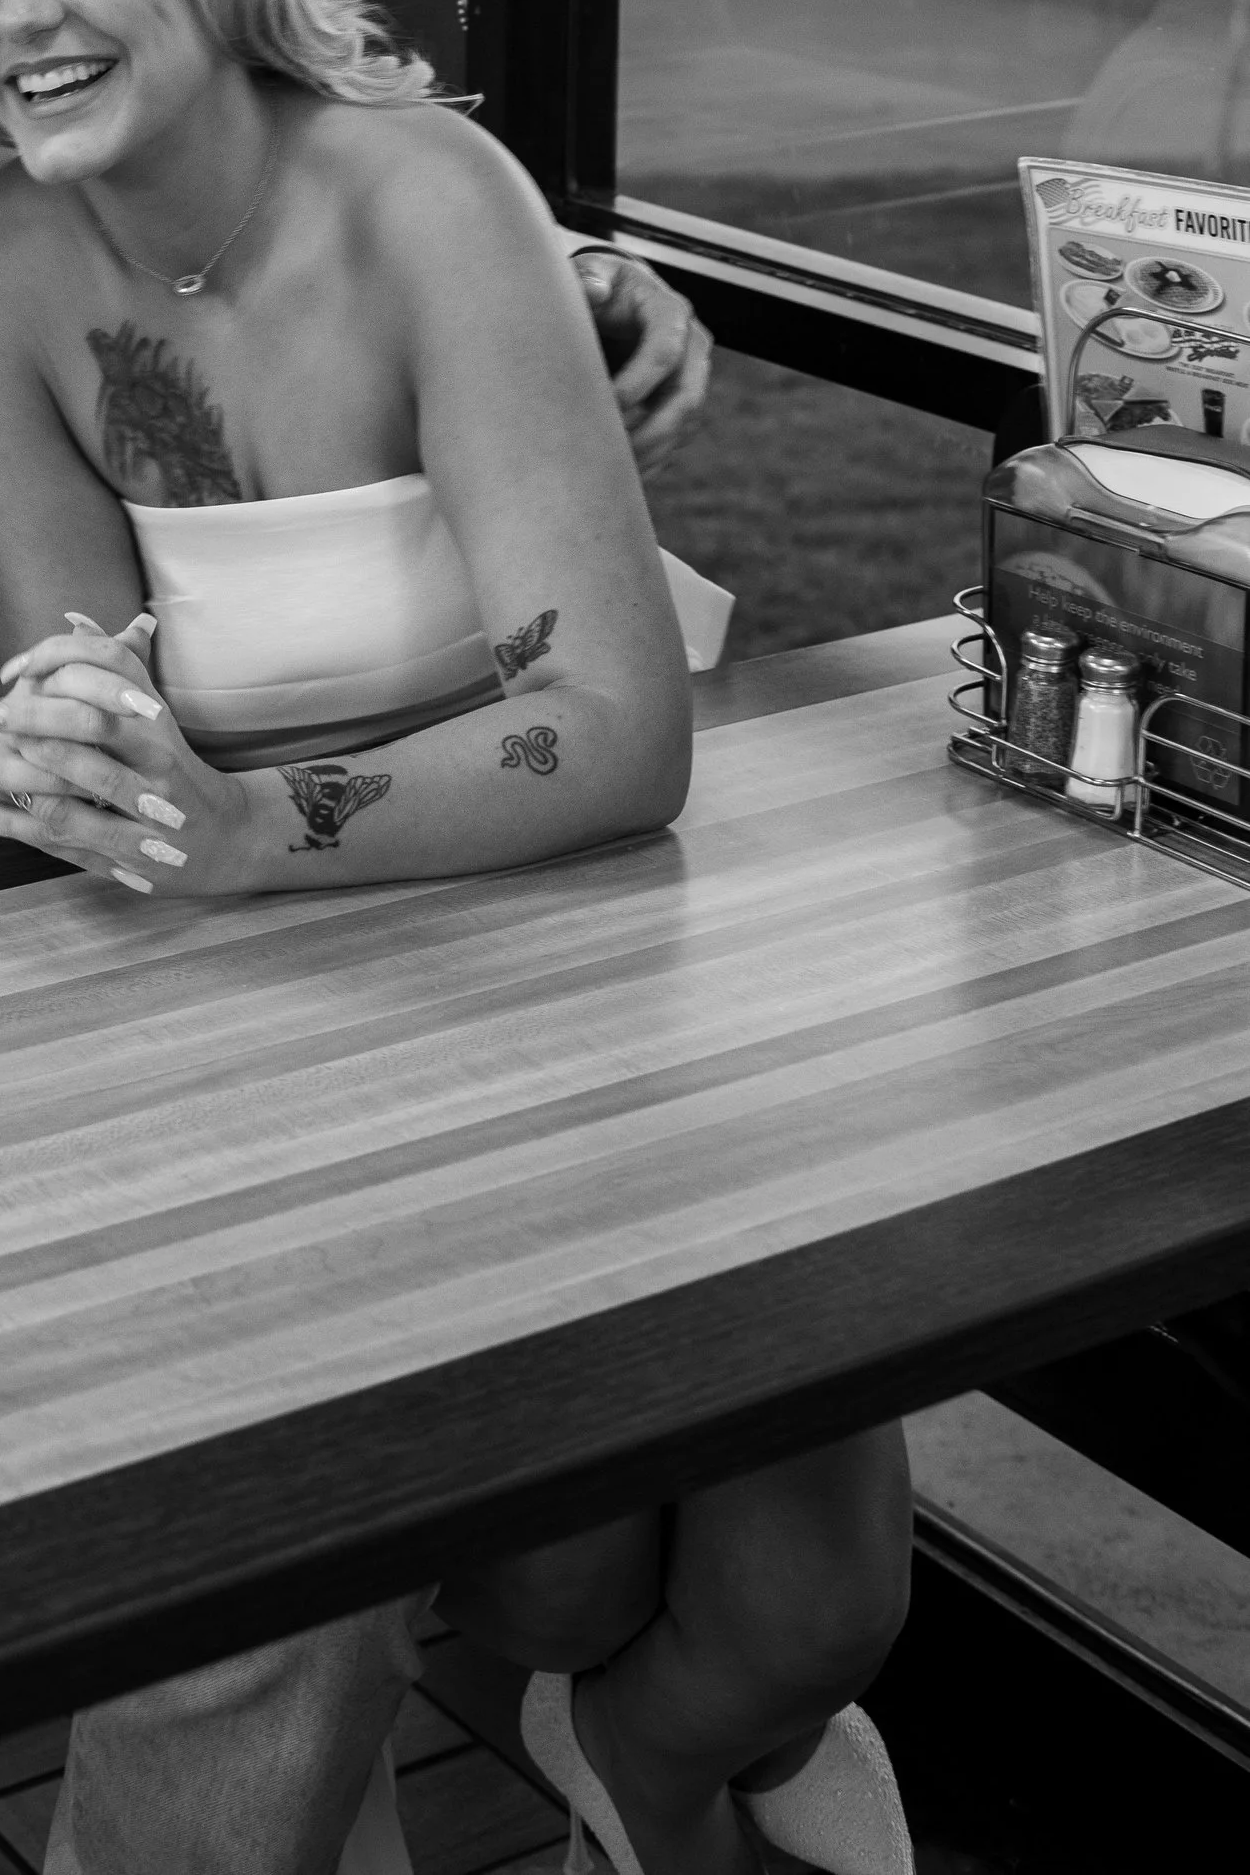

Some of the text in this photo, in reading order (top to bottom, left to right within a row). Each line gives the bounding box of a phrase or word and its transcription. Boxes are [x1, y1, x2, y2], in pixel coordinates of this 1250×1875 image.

[1065, 187, 1170, 234] Breakfast
[1028, 585, 1060, 612] Help
[1061, 594, 1095, 623] keep
[1095, 609, 1118, 629] the
[1119, 621, 1204, 659] environment
